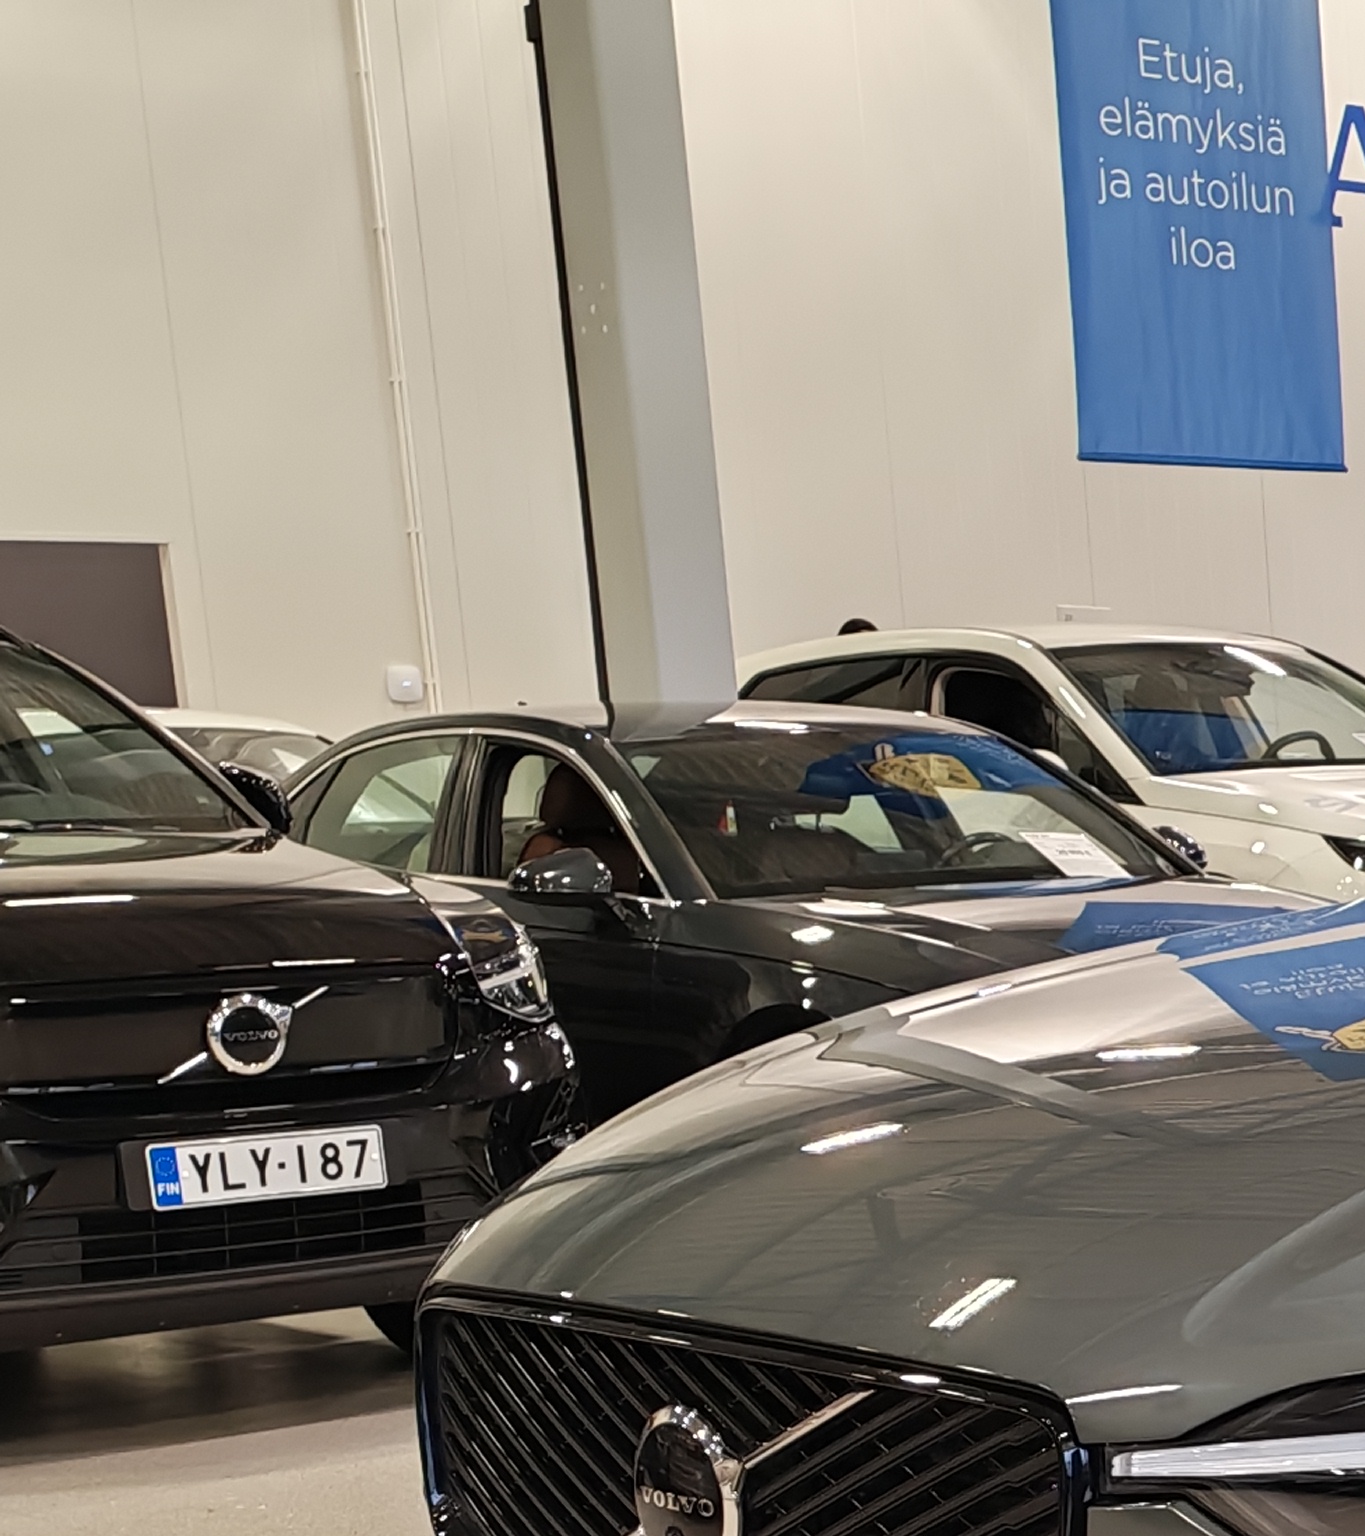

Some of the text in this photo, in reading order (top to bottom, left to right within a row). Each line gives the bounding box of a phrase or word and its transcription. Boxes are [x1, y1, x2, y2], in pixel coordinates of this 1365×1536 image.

[1137, 37, 1244, 96] Etuja,
[1099, 96, 1287, 157] elämyksiä
[1097, 157, 1295, 217] ja autoilun
[1170, 226, 1237, 271] iloa
[223, 1029, 279, 1042] VOLVO
[157, 1139, 368, 1197] FIN YLY-187
[639, 1485, 715, 1518] VOLVO
